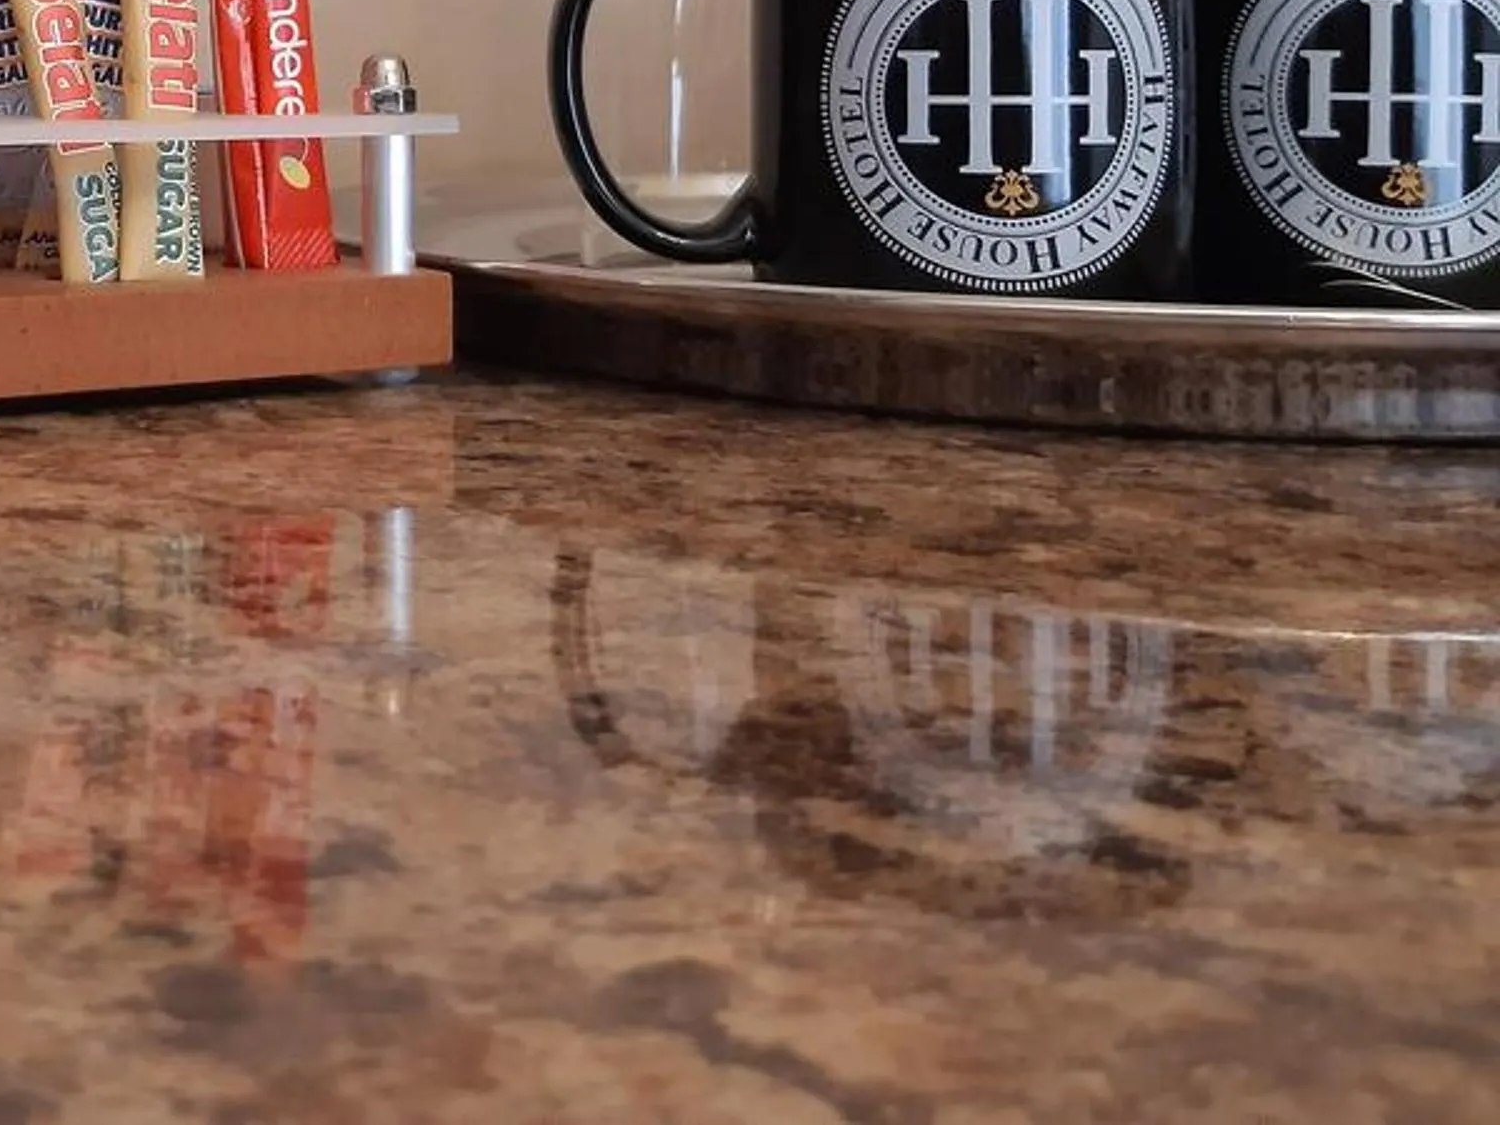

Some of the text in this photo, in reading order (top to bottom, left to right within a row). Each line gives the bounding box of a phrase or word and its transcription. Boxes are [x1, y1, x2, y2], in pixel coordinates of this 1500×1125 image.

[75, 174, 118, 280] SUGA
[155, 139, 189, 264] SUGAR
[839, 75, 1167, 273] HALFWAY HOUSE HOTEL
[1240, 74, 1452, 261] HOUSE HOTEL
